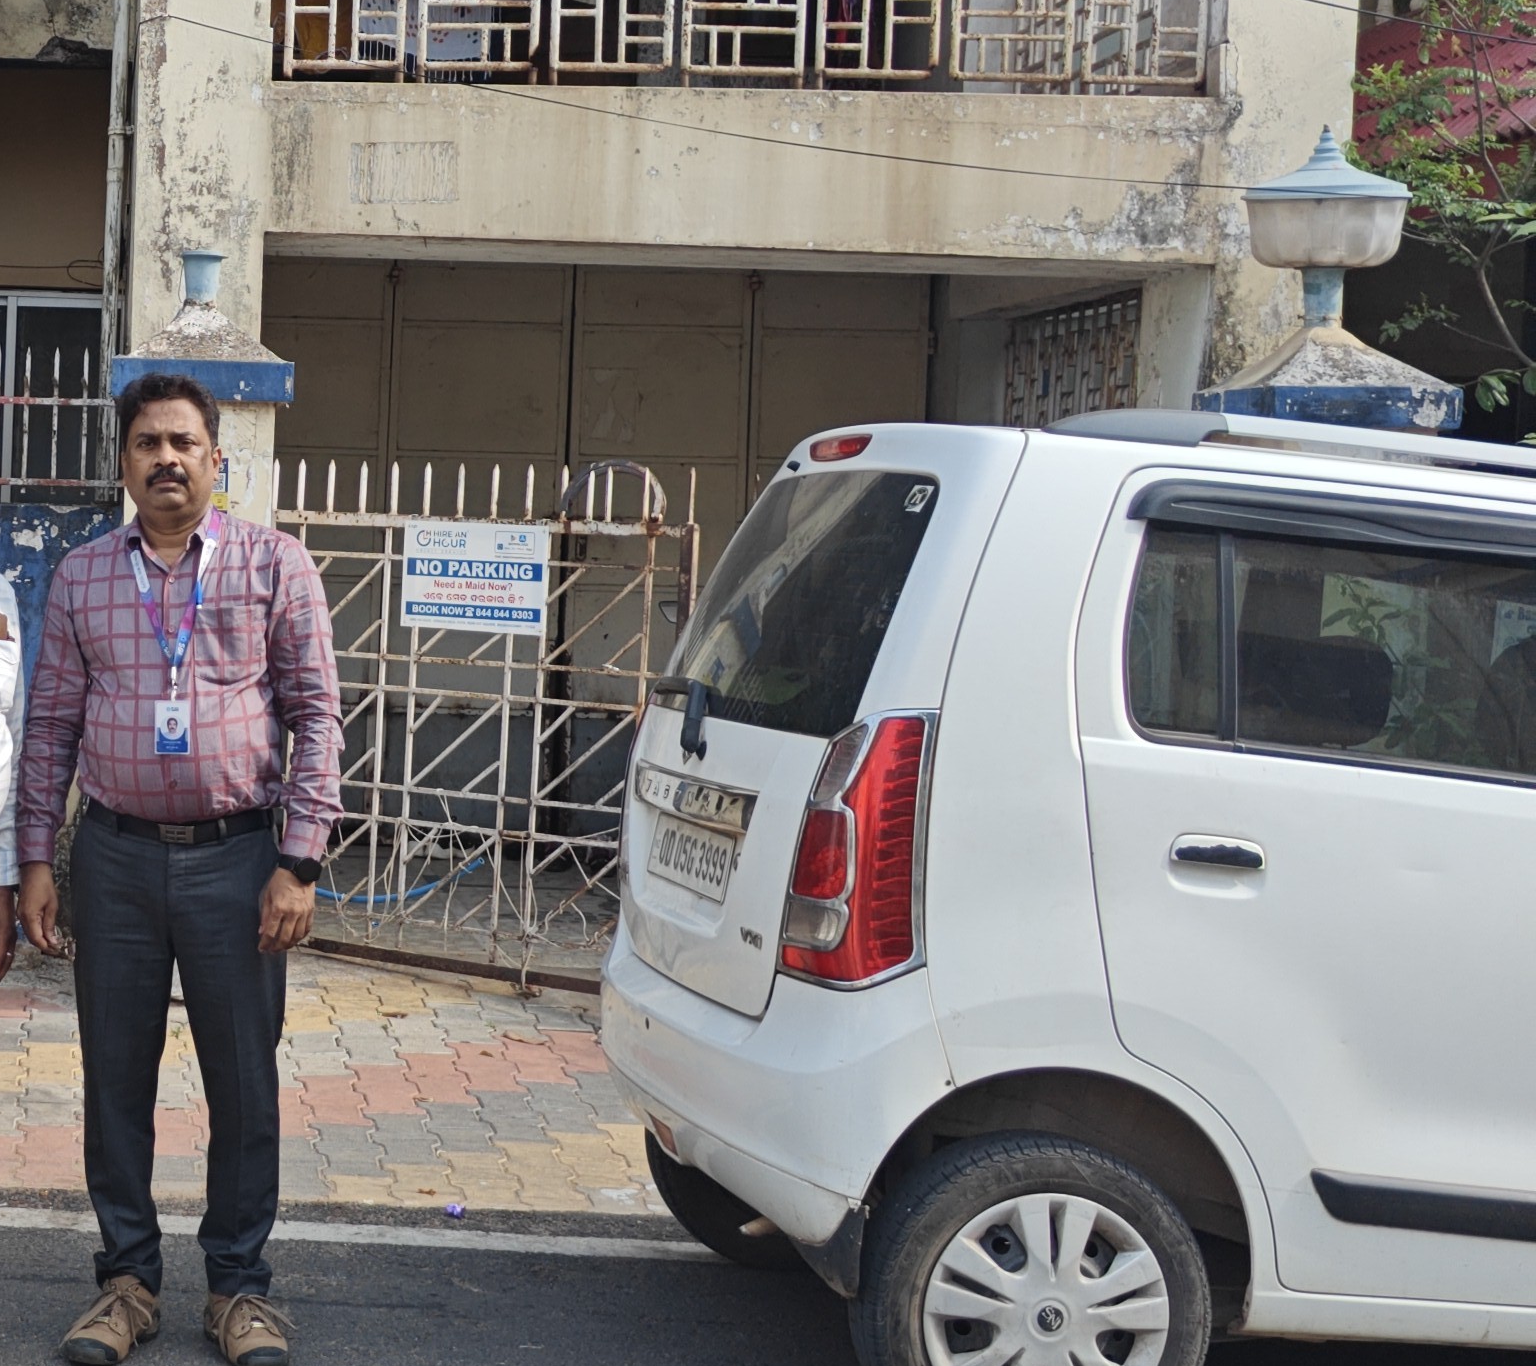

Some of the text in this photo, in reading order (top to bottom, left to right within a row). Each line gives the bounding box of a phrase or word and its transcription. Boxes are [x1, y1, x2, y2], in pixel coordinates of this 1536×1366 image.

[433, 538, 467, 549] HOUR
[415, 559, 534, 580] NO PARKING
[433, 580, 455, 590] Need
[465, 581, 486, 591] Maid
[488, 582, 513, 592] Now?
[411, 604, 534, 620] BOOK NOW 844 844 9303
[695, 841, 727, 887] 3999
